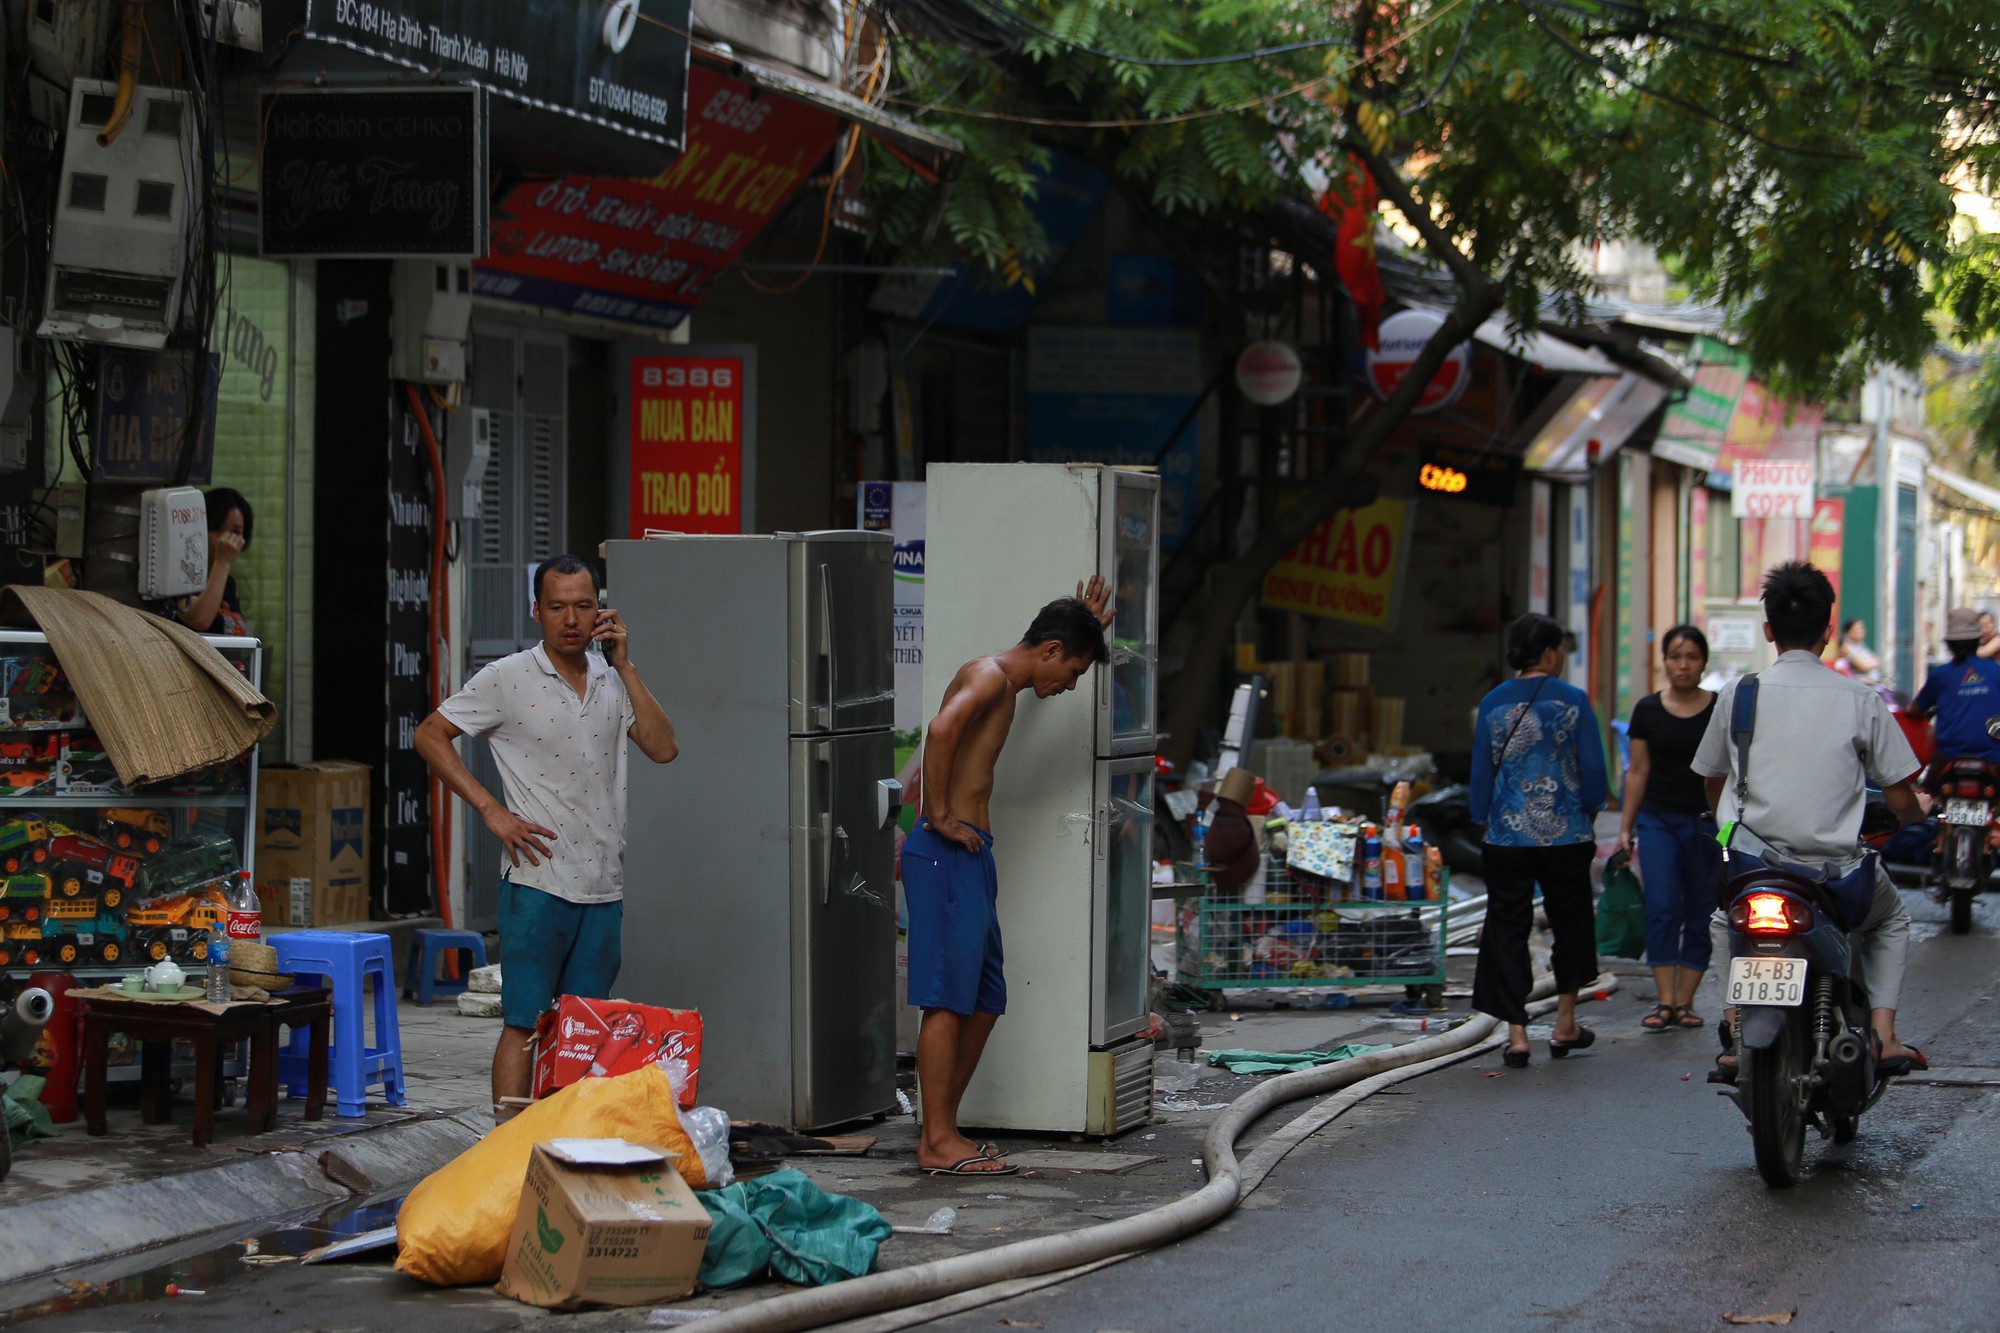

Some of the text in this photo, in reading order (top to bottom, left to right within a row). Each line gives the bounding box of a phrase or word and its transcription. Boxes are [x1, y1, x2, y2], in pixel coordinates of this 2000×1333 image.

[360, 3, 379, 36] 184
[380, 8, 397, 48] Hạ
[429, 24, 461, 62] Thanh
[462, 35, 489, 71] Xuân
[495, 46, 510, 77] Hà
[511, 51, 528, 88] Nội
[275, 111, 309, 140] Hair
[315, 112, 370, 139] Salon
[525, 231, 602, 265] LAPTOP
[642, 366, 733, 388] 8386
[640, 389, 734, 443] MUA BÁN
[107, 414, 143, 473] HẠ
[641, 454, 732, 517] TRAO ĐỔI
[1739, 463, 1809, 516] PHOTO COPY
[388, 567, 430, 613] Highlight
[900, 608, 923, 617] CHUA
[394, 642, 421, 682] Phục
[1742, 961, 1795, 981] 34-B3
[1732, 981, 1799, 1002] 818.50
[587, 1247, 640, 1259] 3314722
